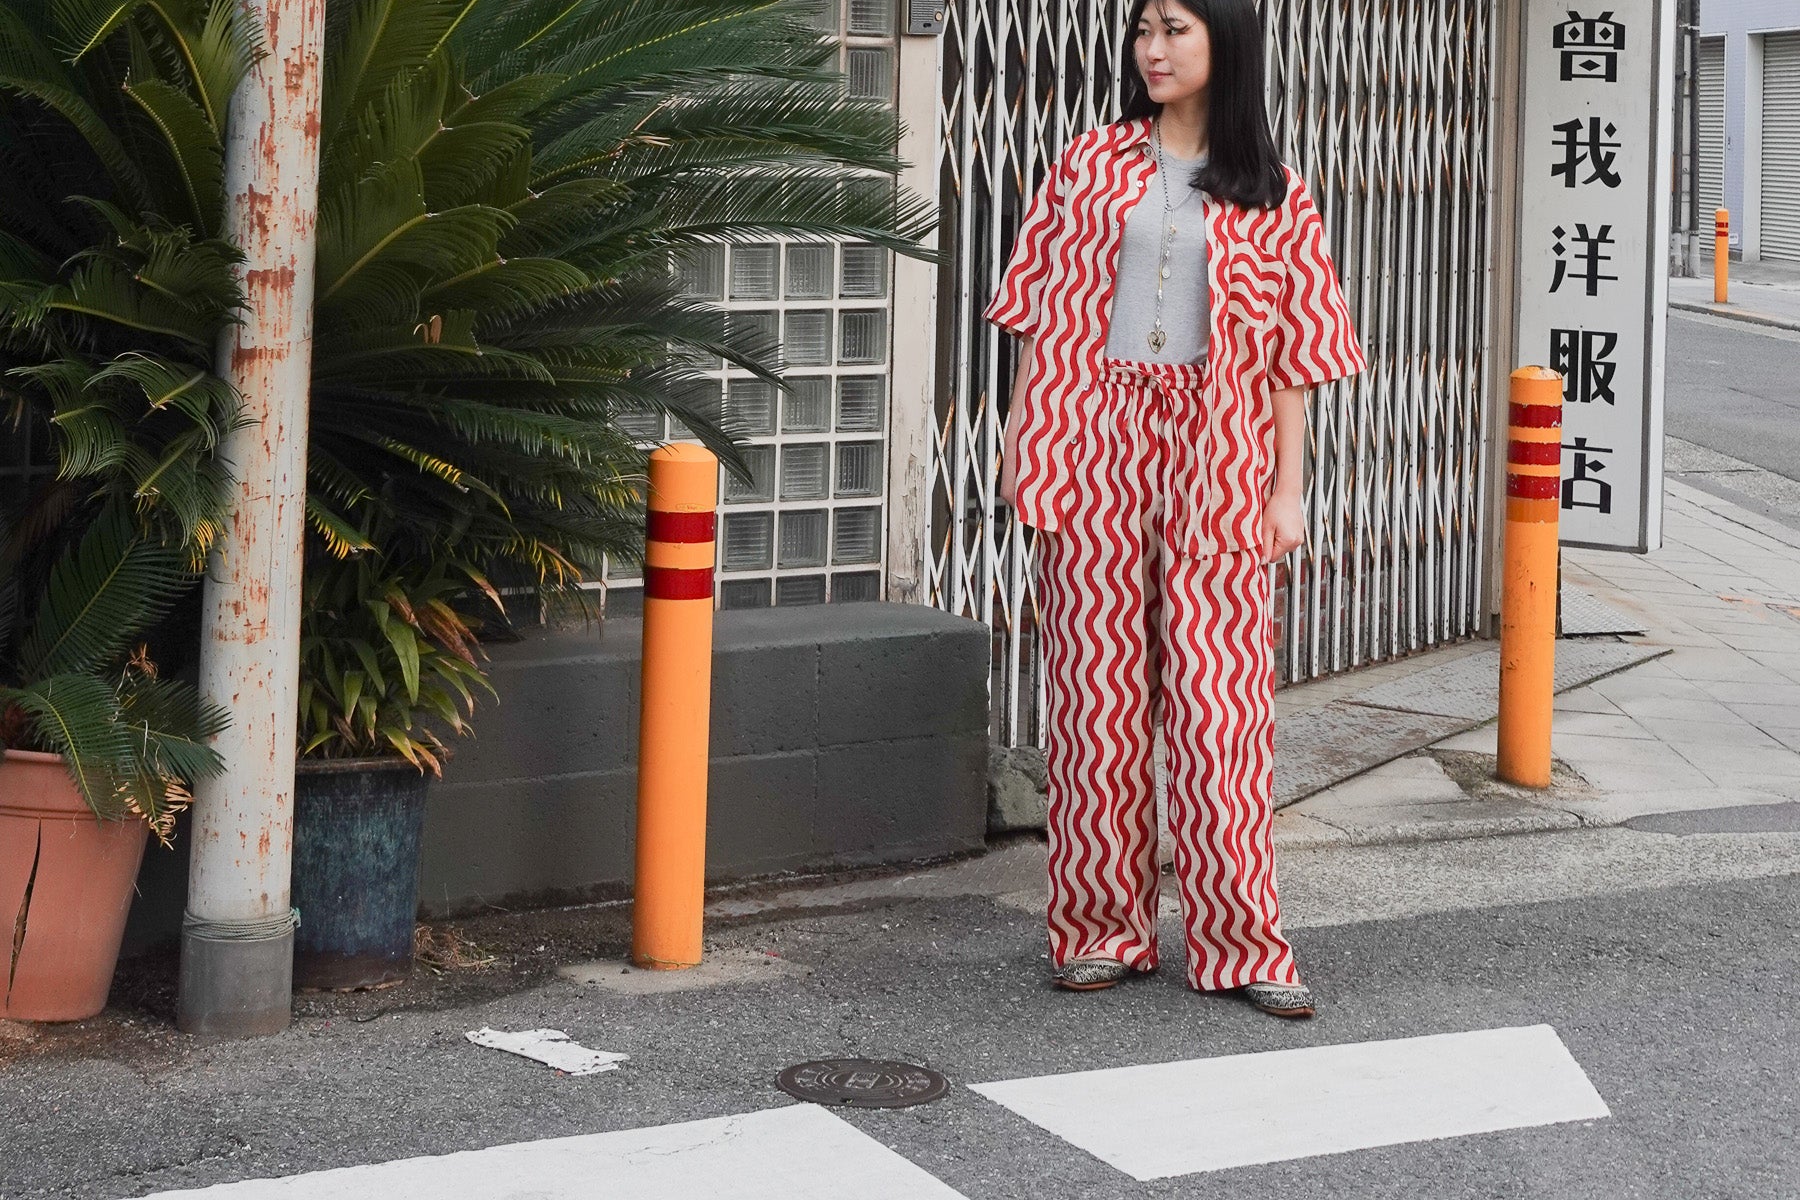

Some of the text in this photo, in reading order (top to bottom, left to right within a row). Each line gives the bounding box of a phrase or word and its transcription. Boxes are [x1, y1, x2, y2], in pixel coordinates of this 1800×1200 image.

[1549, 11, 1626, 514] 曾我洋服店
